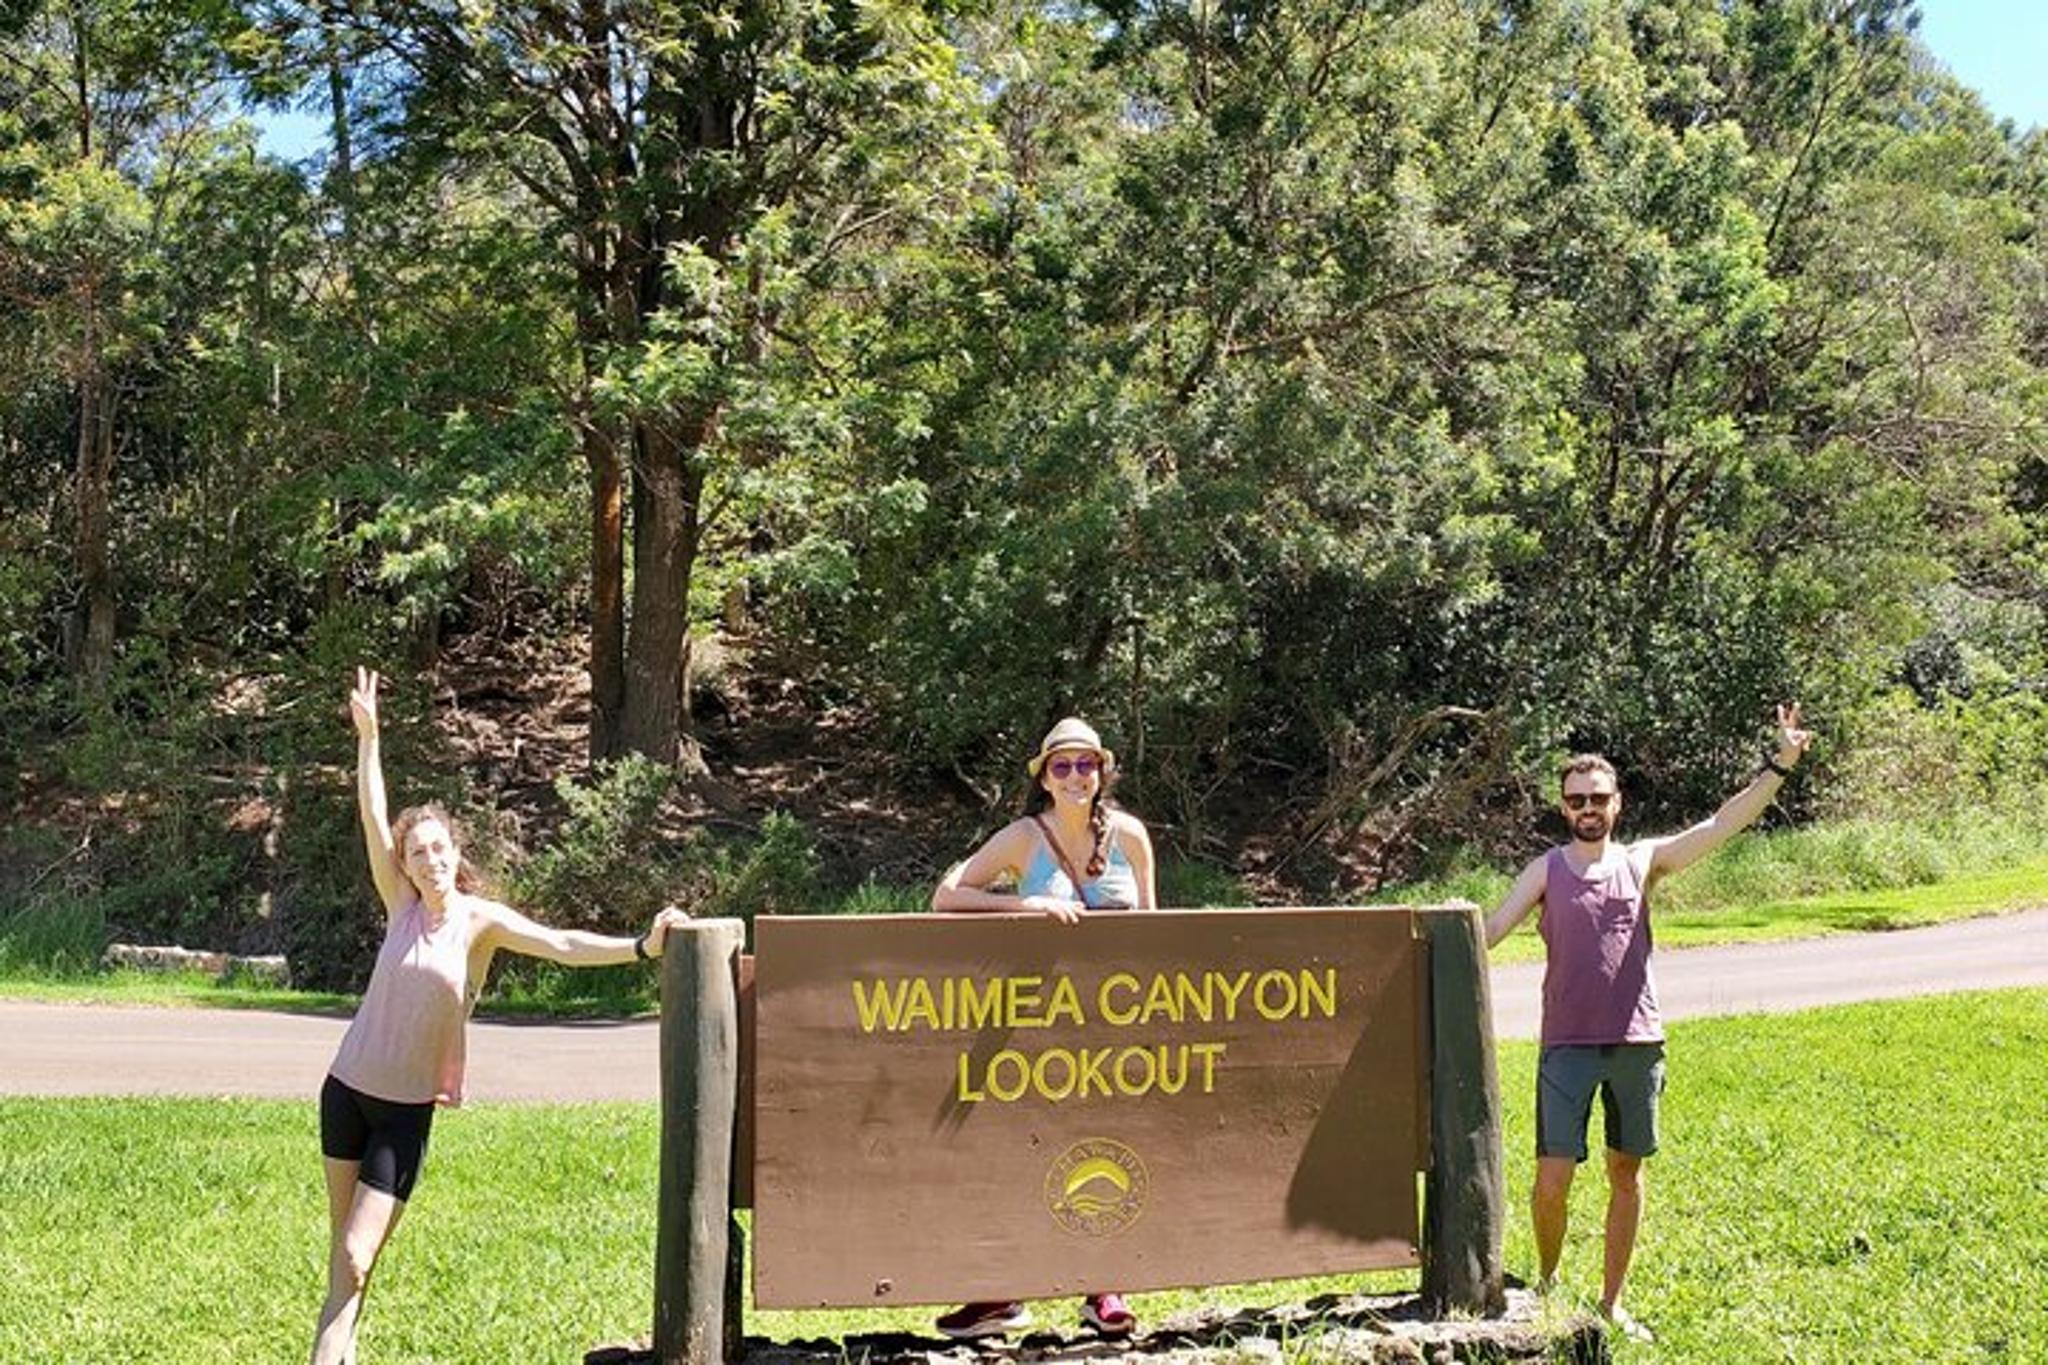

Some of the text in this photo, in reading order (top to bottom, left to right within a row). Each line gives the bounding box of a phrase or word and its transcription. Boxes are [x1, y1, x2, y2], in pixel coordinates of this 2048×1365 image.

[852, 968, 1337, 1032] WAIMEA CANYON
[958, 1042, 1224, 1103] LOOKOUT
